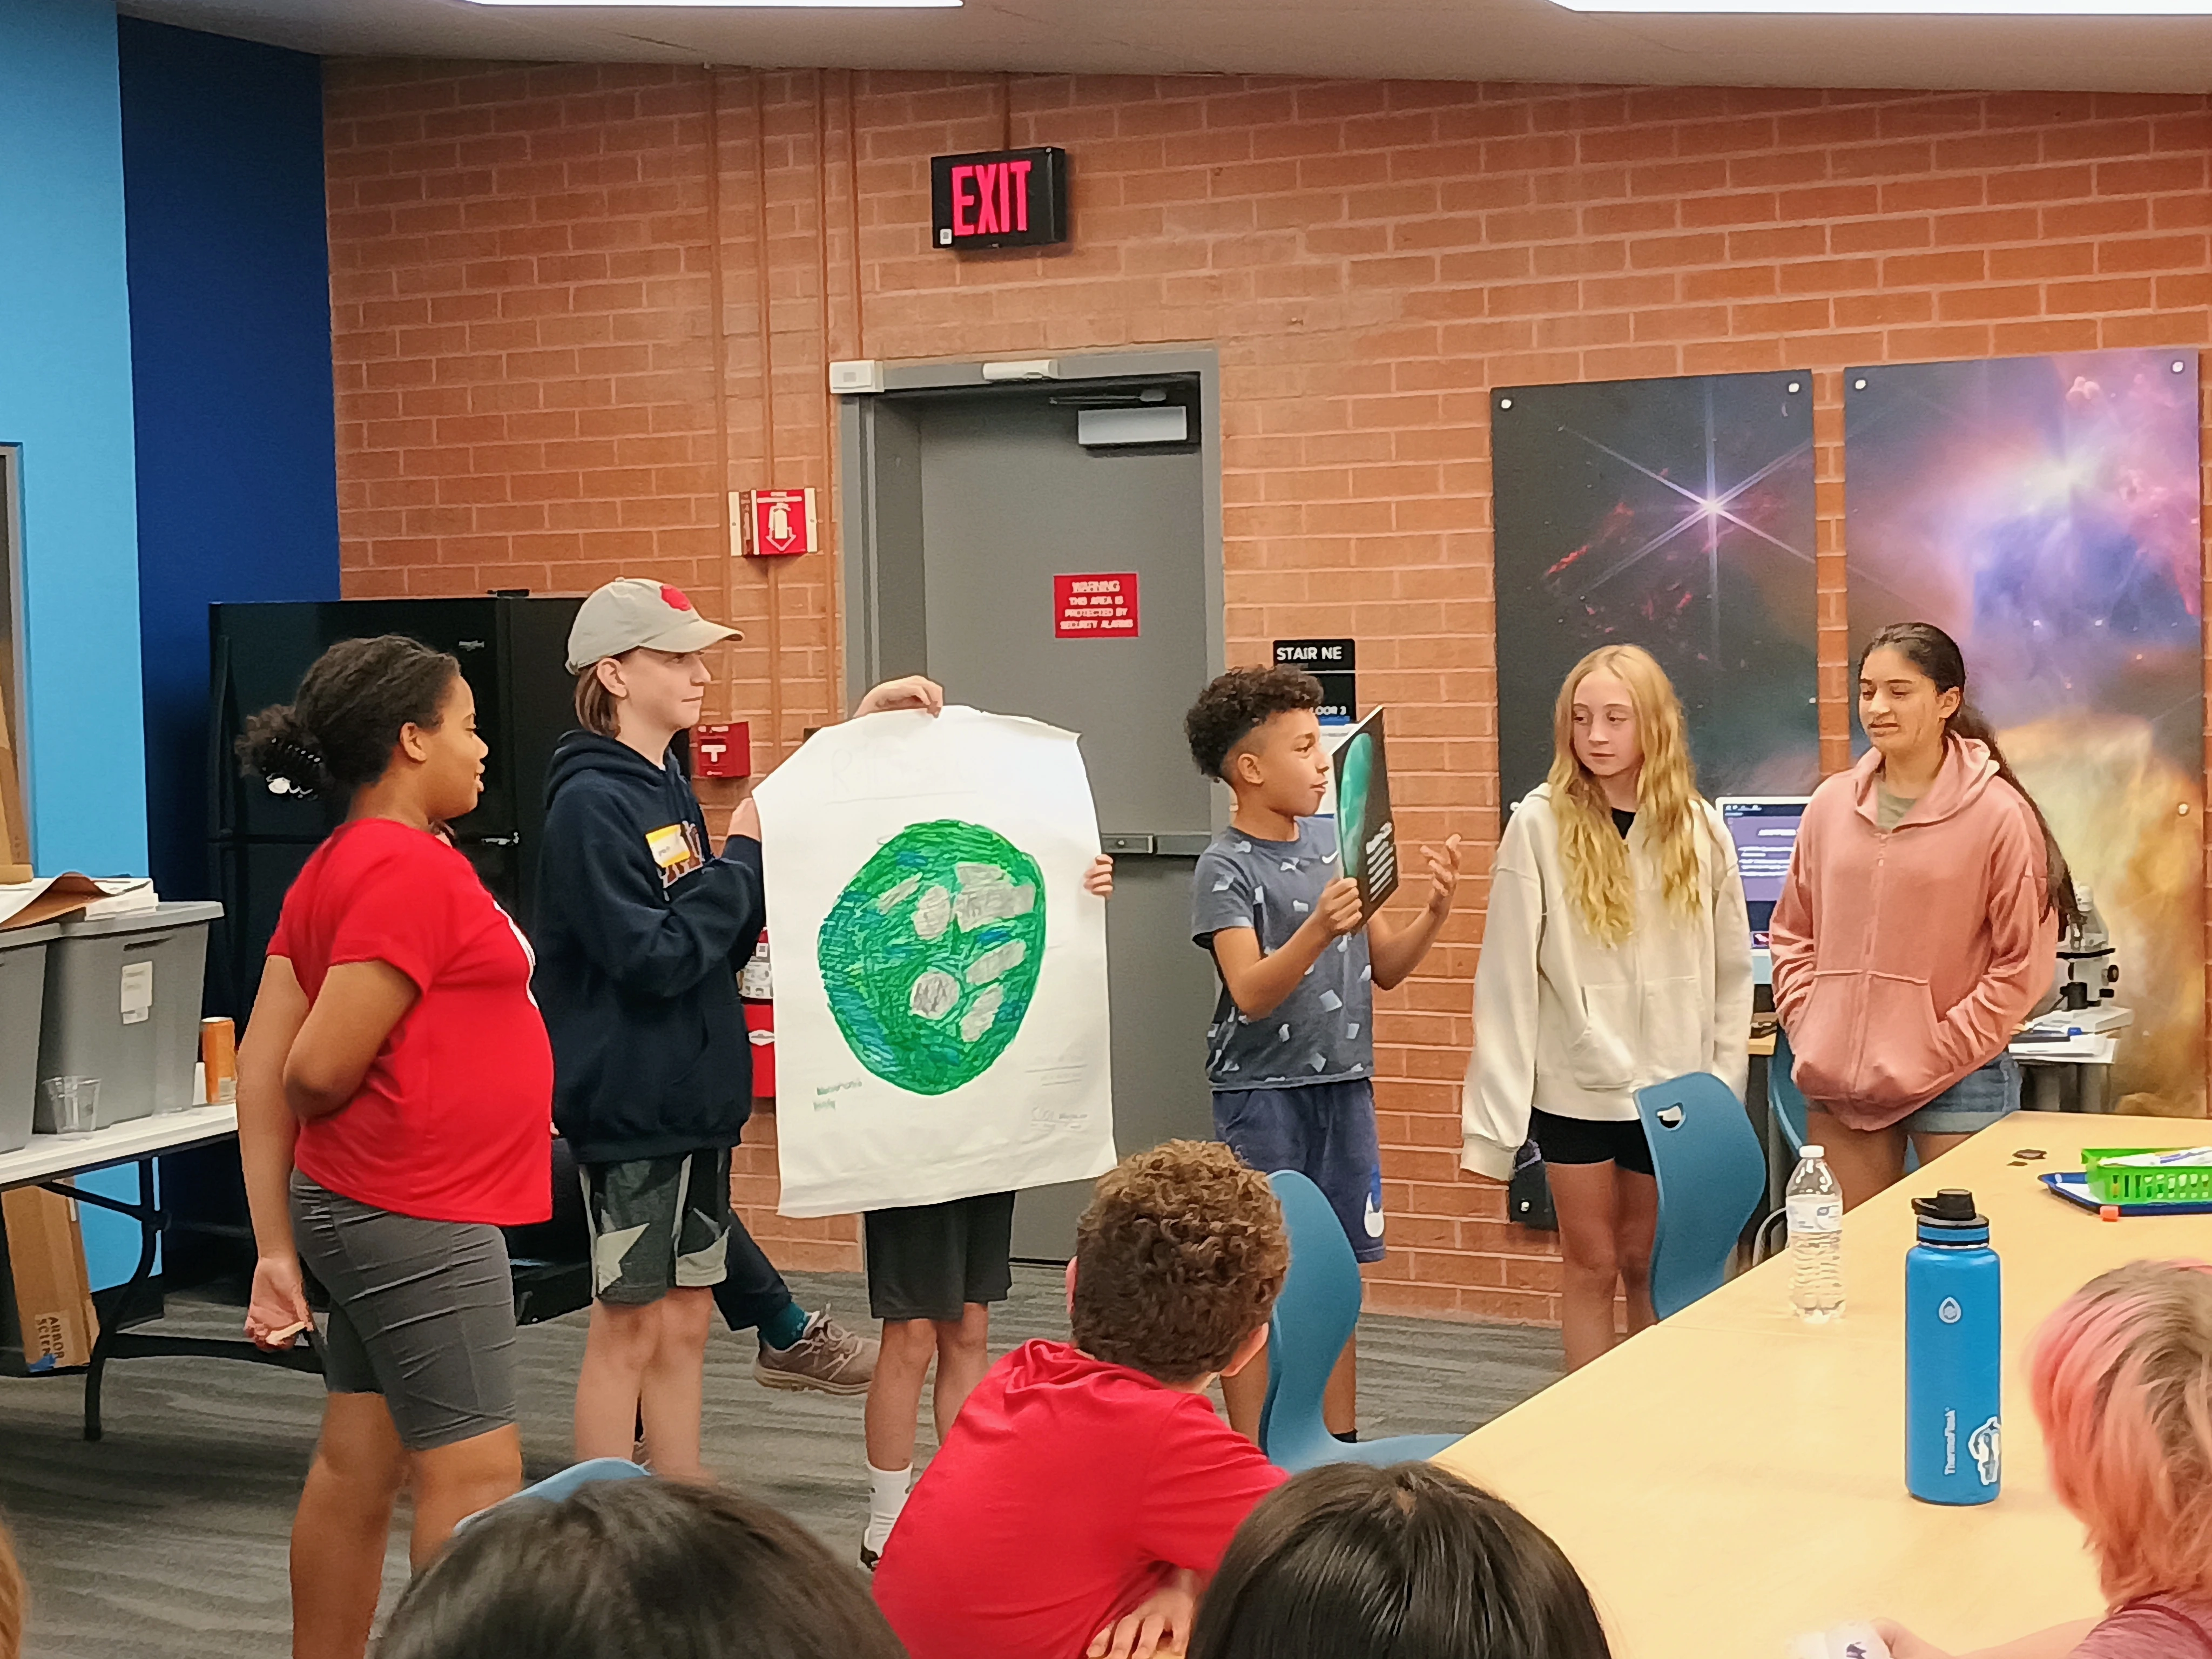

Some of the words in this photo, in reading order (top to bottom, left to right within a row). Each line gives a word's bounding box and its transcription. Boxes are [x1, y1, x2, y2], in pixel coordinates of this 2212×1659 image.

[952, 160, 1031, 236] EXIT
[1072, 581, 1120, 593] WARNING
[1069, 596, 1087, 605] THIS
[1090, 596, 1112, 605] AREA
[1115, 596, 1124, 604] IS
[1065, 608, 1114, 617] PROTECTED
[1116, 607, 1128, 616] BY
[1060, 621, 1098, 629] SECURITY
[1277, 646, 1318, 660] STAIR
[1321, 646, 1343, 660] NE
[1309, 706, 1338, 715] OOR
